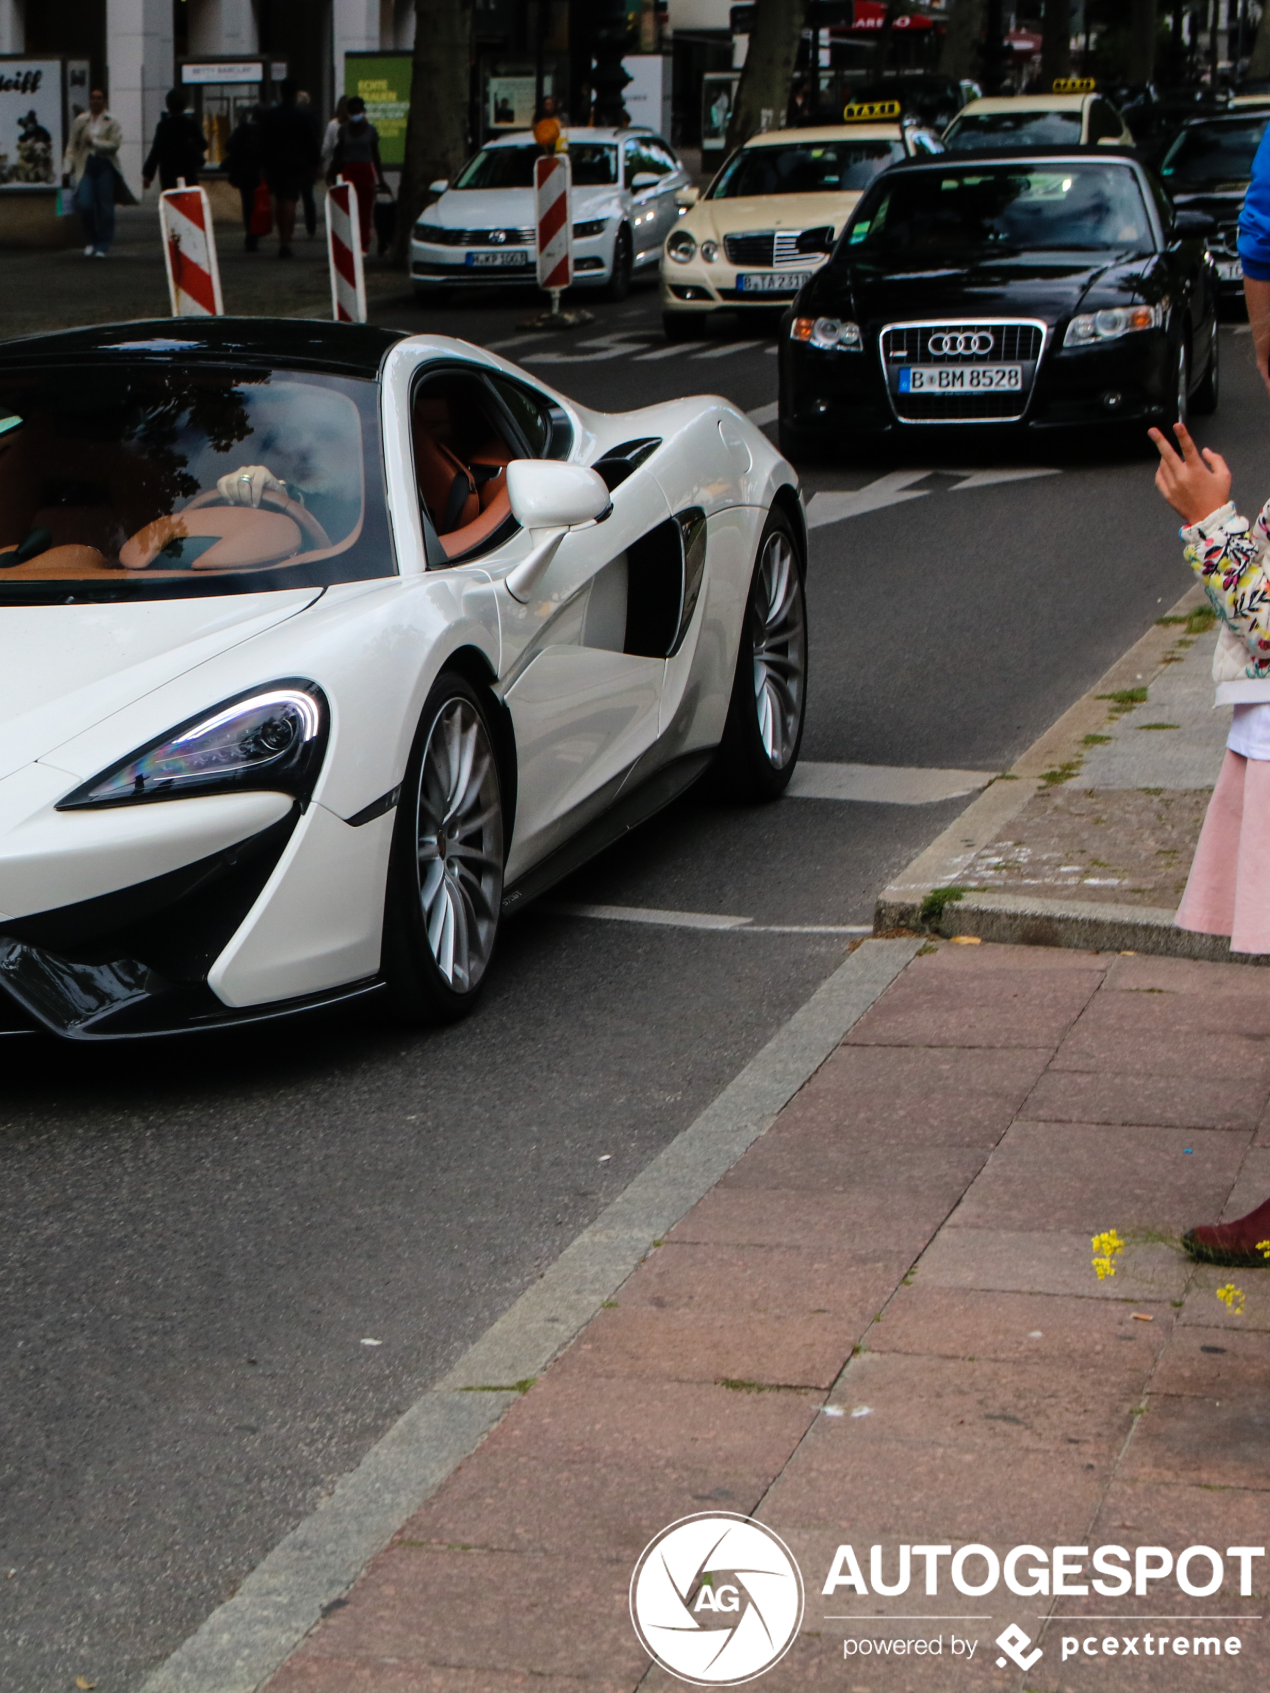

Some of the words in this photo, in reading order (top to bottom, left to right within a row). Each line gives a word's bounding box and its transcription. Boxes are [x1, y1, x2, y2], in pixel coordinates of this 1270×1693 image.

[850, 103, 893, 118] TAXI
[912, 371, 924, 389] B
[938, 370, 964, 389] BM
[969, 369, 1019, 388] 8528
